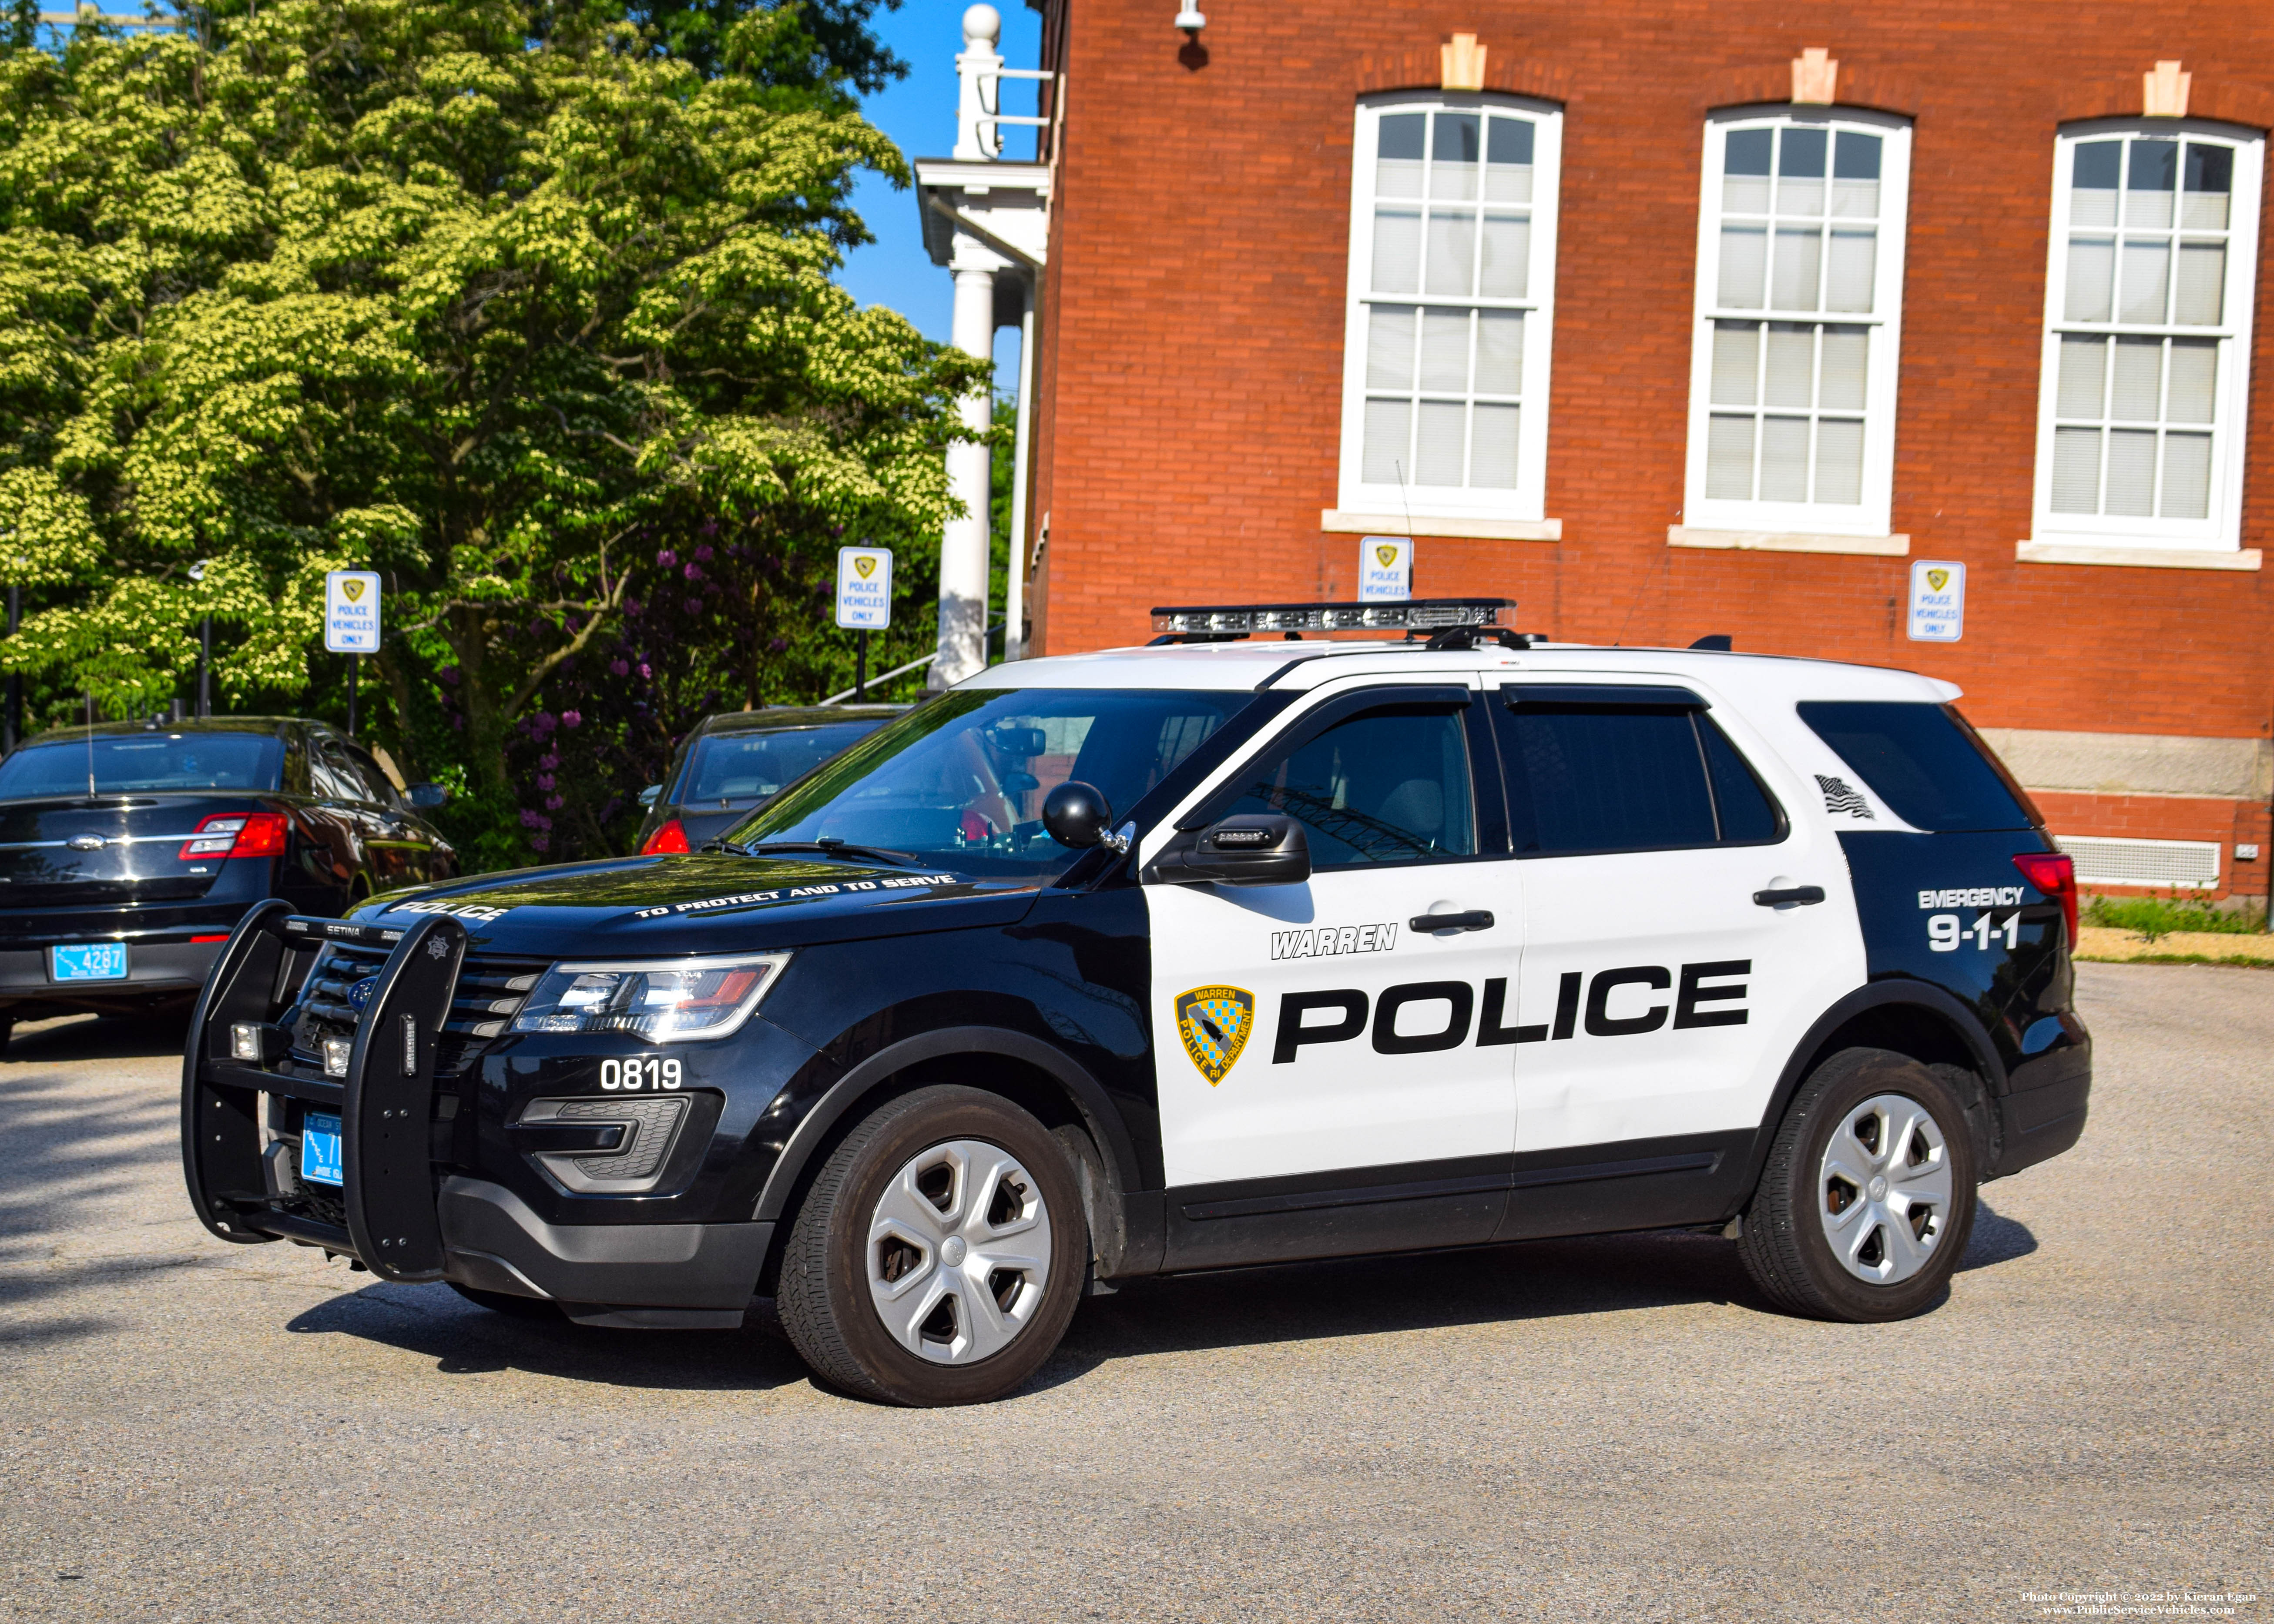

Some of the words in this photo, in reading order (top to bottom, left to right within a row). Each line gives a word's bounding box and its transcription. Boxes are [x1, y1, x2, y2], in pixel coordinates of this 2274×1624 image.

[1371, 570, 1400, 581] POLICE
[849, 582, 878, 593] POLICE
[1365, 585, 1405, 596] VEHICLES
[843, 596, 884, 607] VEHICLES
[1922, 594, 1952, 605] POLICE
[338, 605, 367, 616] POLICE
[852, 611, 874, 621] ONLY
[1916, 608, 1958, 619] VEHICLES
[332, 619, 374, 630] VEHICLES
[1925, 623, 1946, 634] ONLY
[342, 634, 363, 645] ONLY
[635, 907, 669, 917] TO
[675, 891, 779, 911] PROTECT
[790, 885, 839, 897] AND
[843, 881, 876, 891] TO
[881, 875, 956, 888] SERVE
[1918, 887, 2024, 909] EMERGENCY
[389, 901, 509, 921] POLICE
[327, 925, 360, 936] SETINA
[1927, 911, 2021, 952] 9-1-1
[1271, 923, 1398, 960] WARREN
[82, 950, 121, 969] 4287
[1194, 989, 1236, 1000] WARREN
[1271, 959, 1753, 1065] POLICE
[1180, 1019, 1209, 1070] POLICE
[1221, 1008, 1251, 1070] DEPARTMENT
[601, 1059, 681, 1089] 0819
